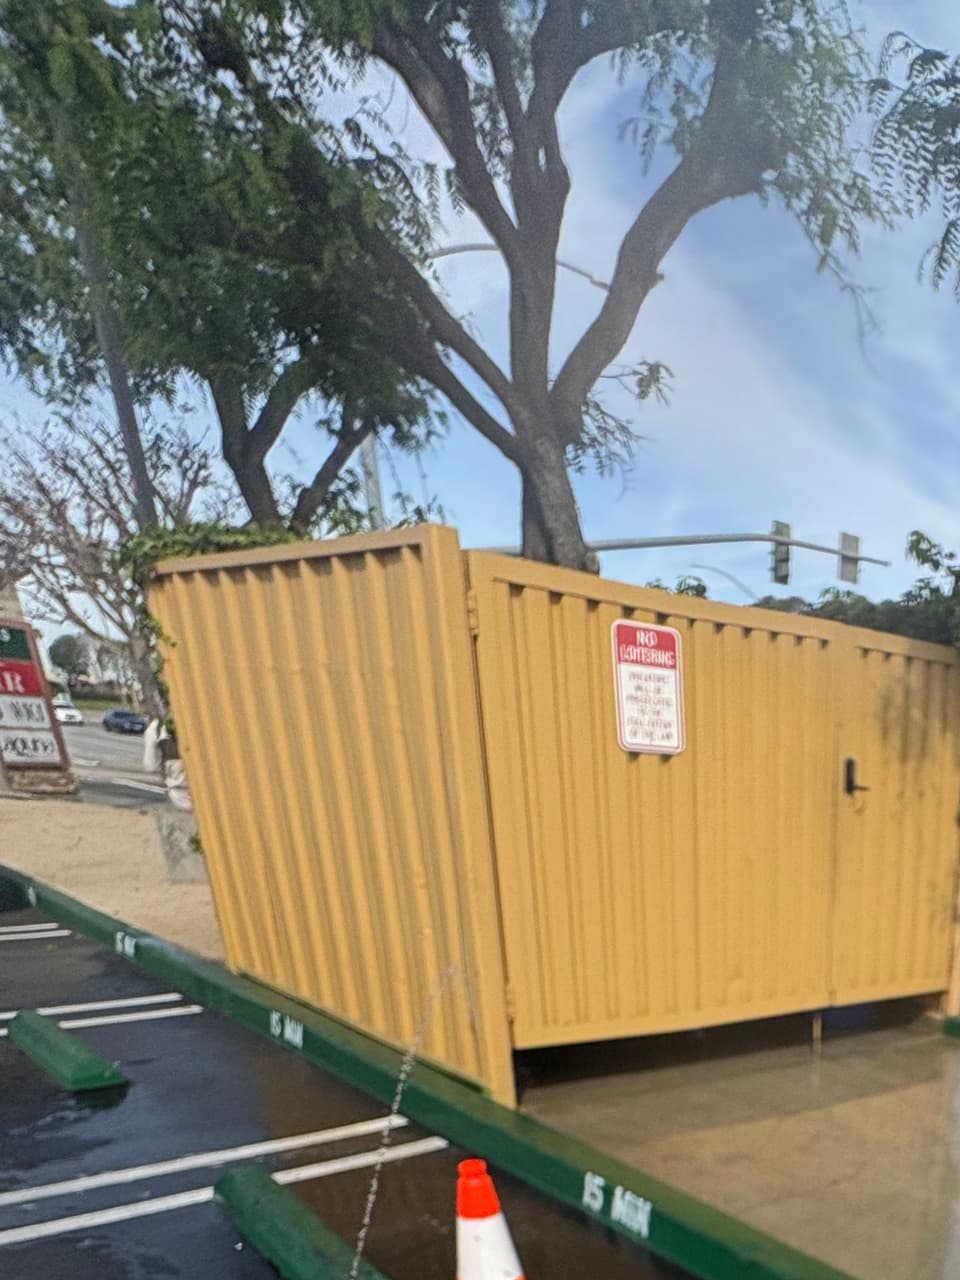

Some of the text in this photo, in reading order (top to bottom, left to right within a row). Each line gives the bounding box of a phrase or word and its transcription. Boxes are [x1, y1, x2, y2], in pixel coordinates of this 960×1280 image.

[636, 630, 658, 647] NO
[619, 644, 675, 668] LOITERING
[582, 1171, 652, 1239] 15 MIN
